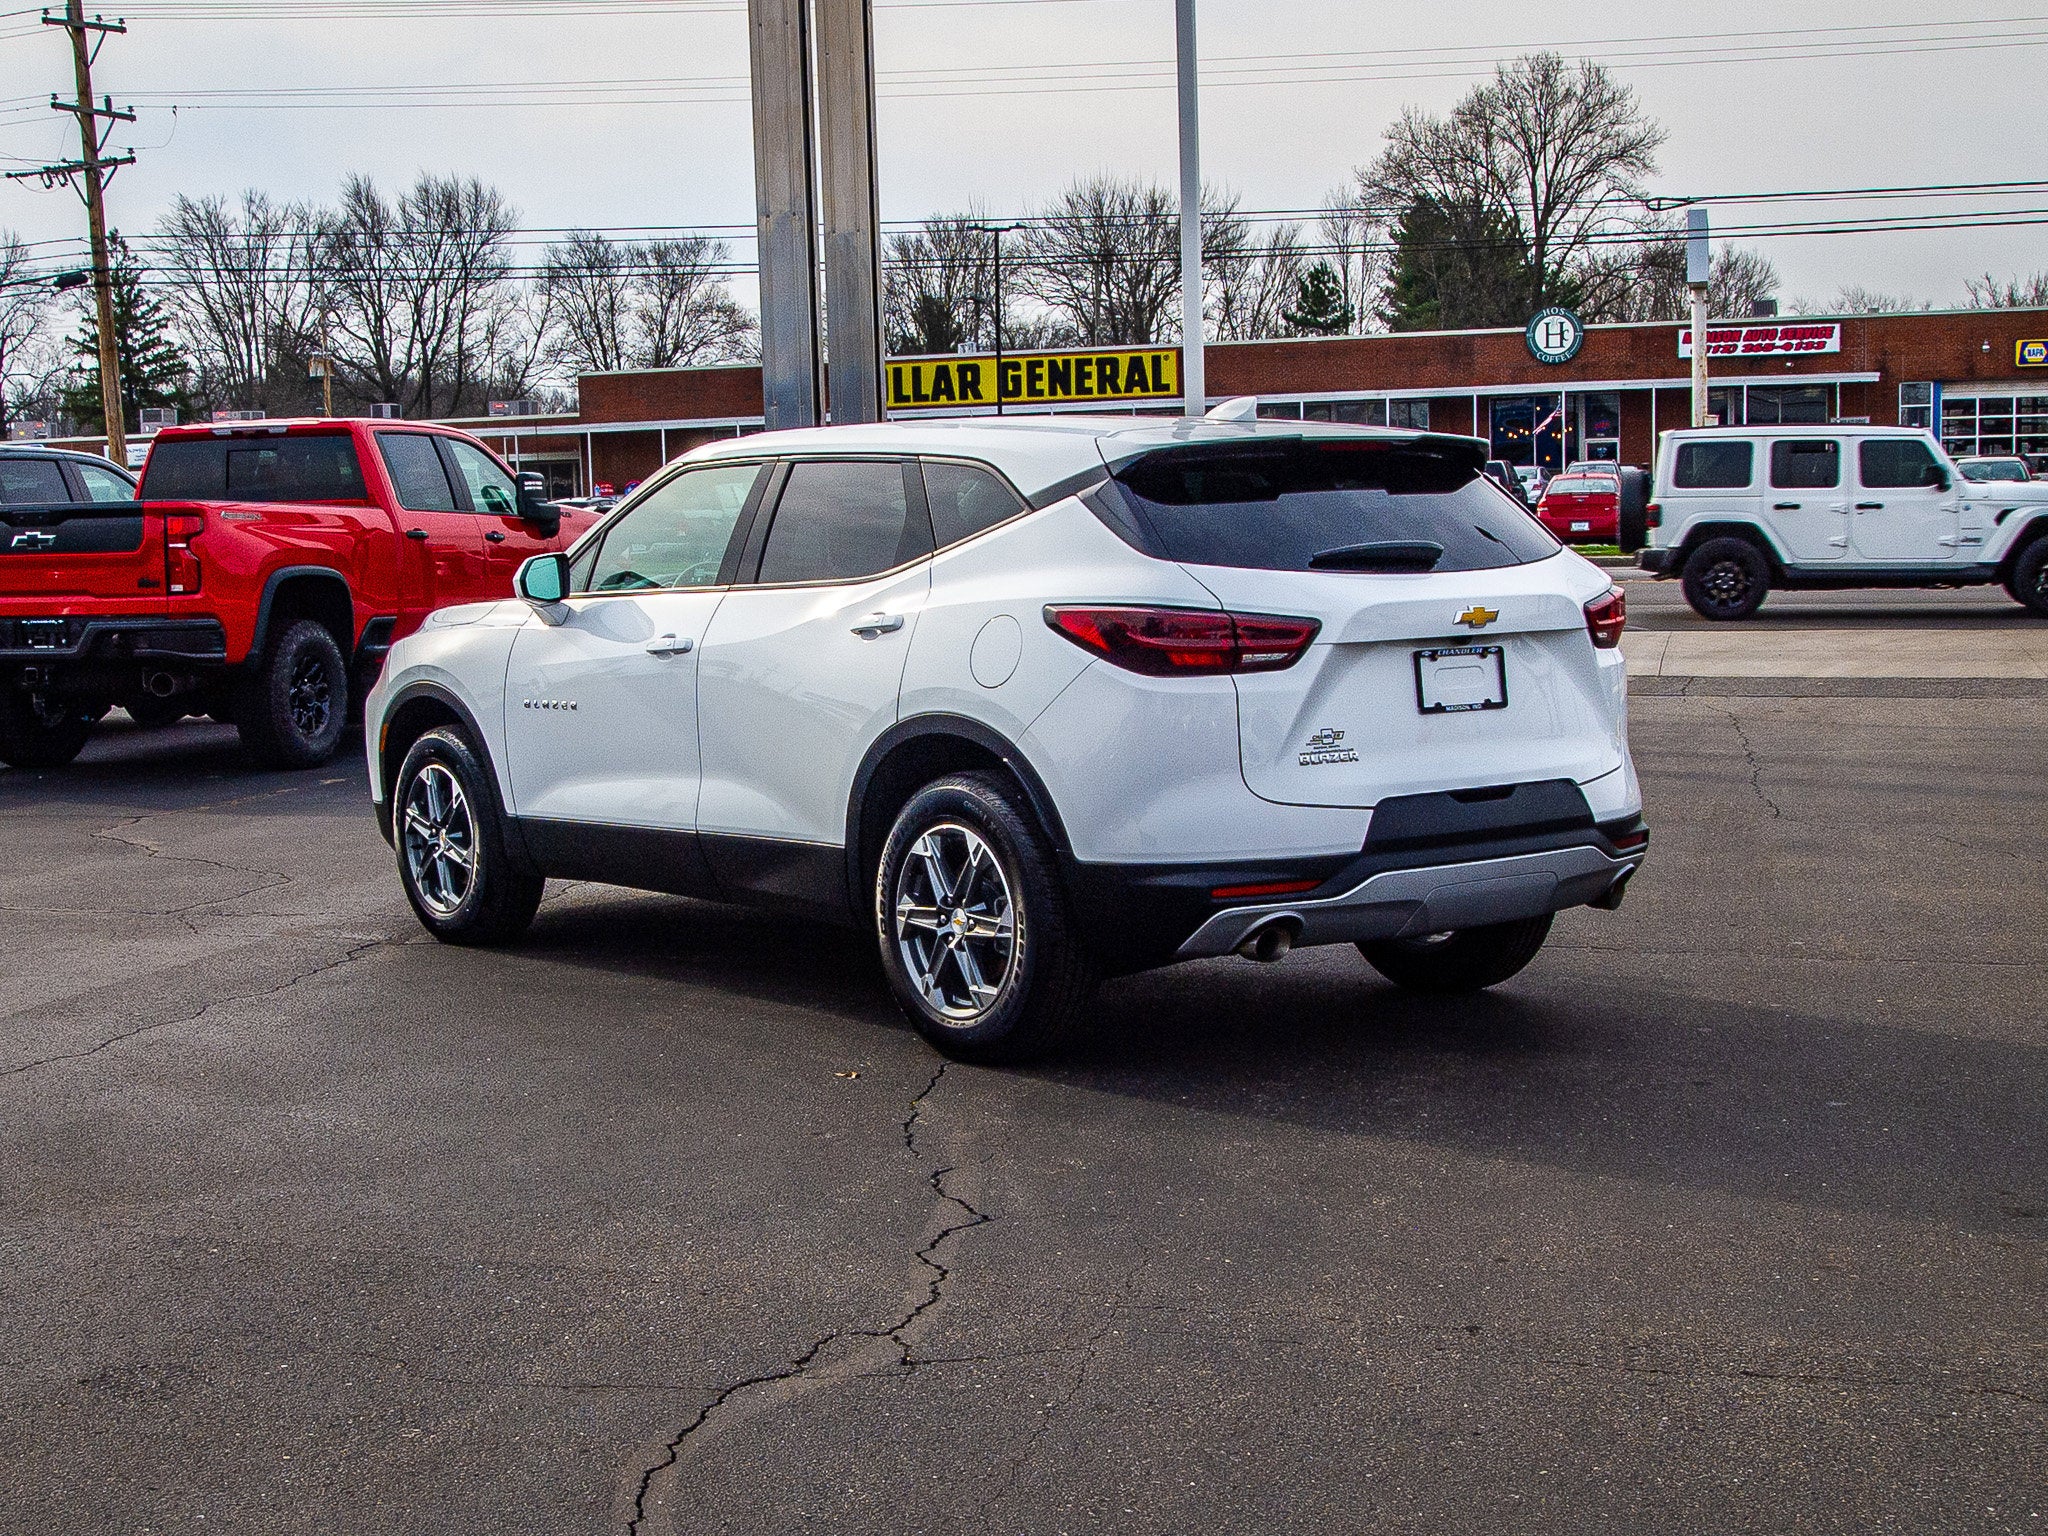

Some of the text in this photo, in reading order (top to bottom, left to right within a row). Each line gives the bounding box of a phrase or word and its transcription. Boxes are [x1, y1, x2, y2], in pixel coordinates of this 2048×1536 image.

[1542, 306, 1566, 317] HOS
[1681, 326, 1835, 345] MDISON AUTO SERVICE
[1536, 351, 1573, 363] COFFEE
[2027, 347, 2045, 358] NAPA
[887, 354, 1170, 403] LLAR GENERAL
[523, 698, 578, 711] BLAZER
[1299, 751, 1359, 766] BLAZER
